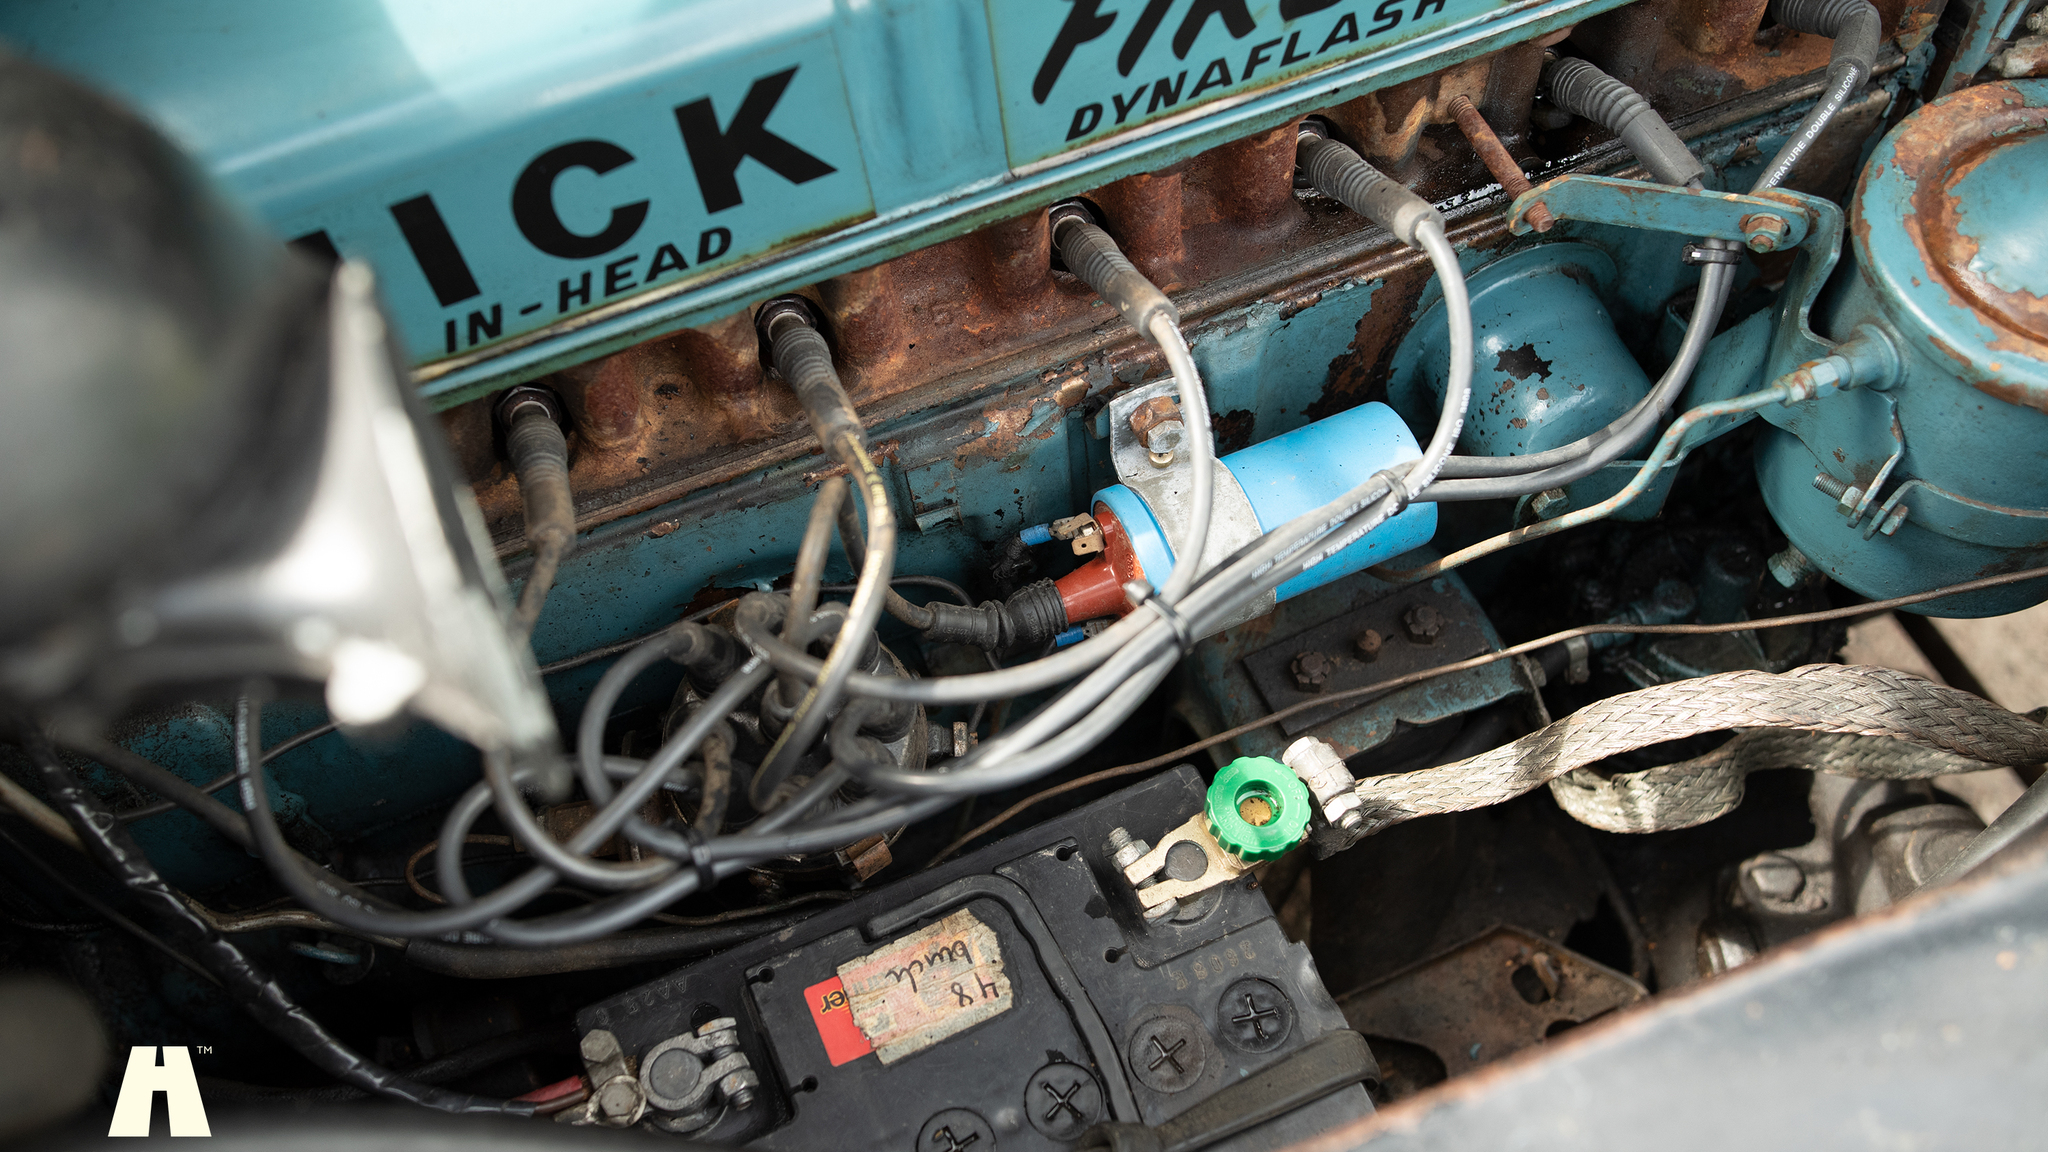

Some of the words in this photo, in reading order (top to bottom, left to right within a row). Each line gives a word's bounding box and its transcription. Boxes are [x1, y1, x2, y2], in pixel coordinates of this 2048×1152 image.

[1032, 0, 1341, 105] FIR
[1065, 0, 1447, 142] DYNAFLASH
[1805, 102, 1836, 140] DOUBLE
[1834, 66, 1858, 102] SILICONE
[287, 63, 838, 308] ICK
[1325, 515, 1385, 559] TEMPERATURE
[1421, 442, 1454, 488] SILICONE
[1451, 418, 1464, 438] ISO
[1329, 504, 1359, 528] DOUBLE
[1359, 486, 1391, 509] SILICON
[950, 973, 1000, 1008] 48
